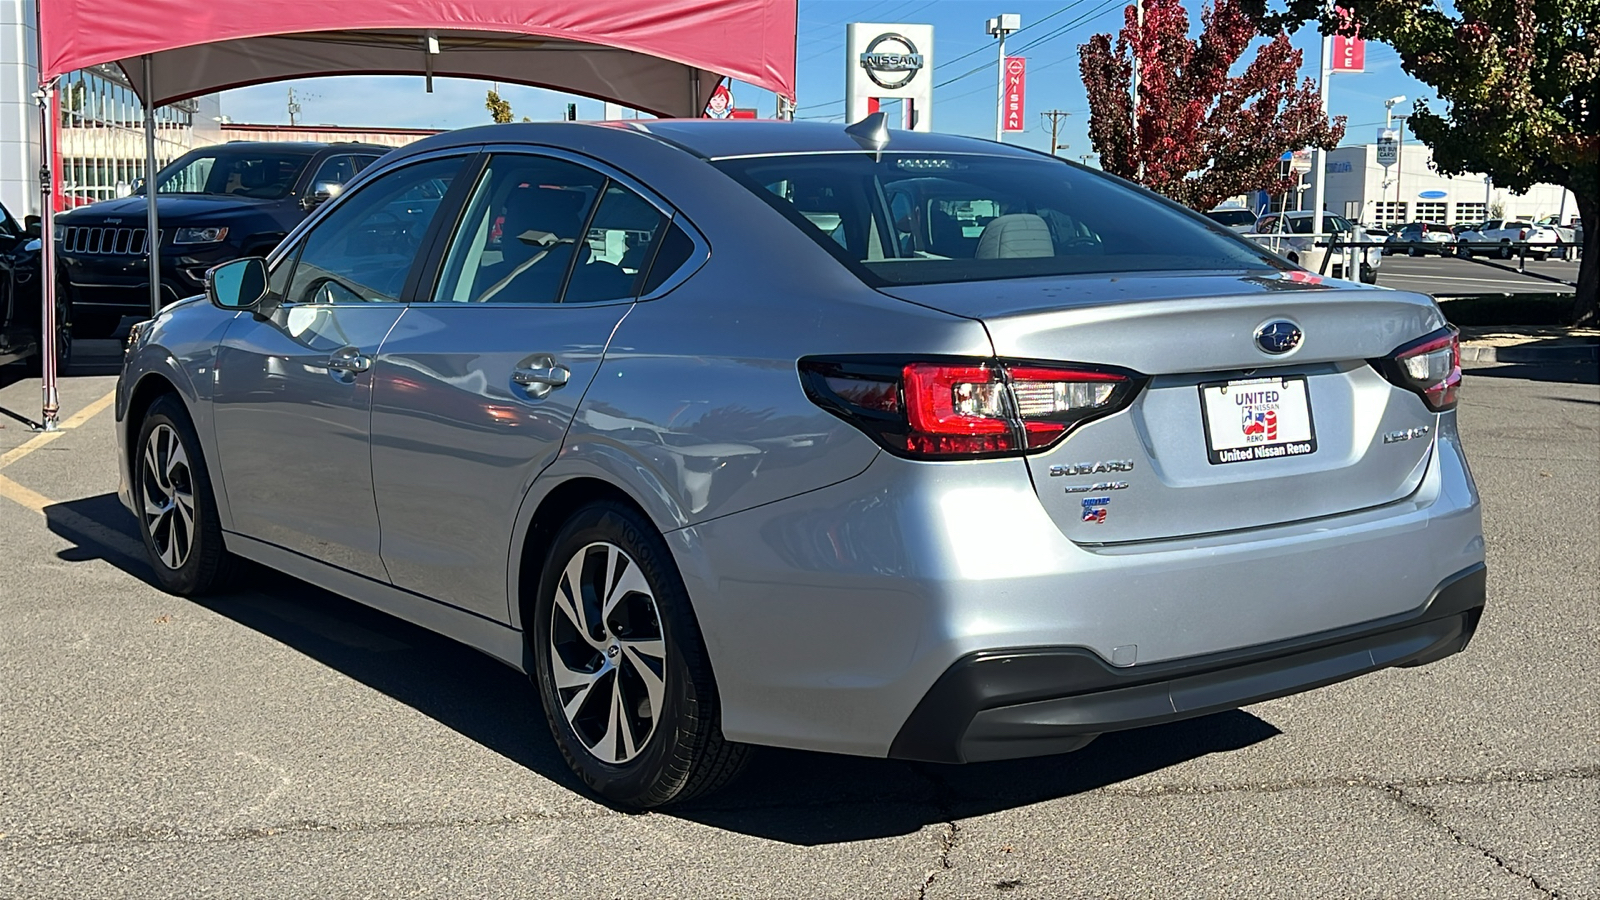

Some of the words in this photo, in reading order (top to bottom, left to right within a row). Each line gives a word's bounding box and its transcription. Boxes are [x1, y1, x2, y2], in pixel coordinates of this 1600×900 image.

[866, 56, 918, 66] NISSAN
[1009, 76, 1020, 128] NISSAN
[1235, 391, 1280, 406] UNITED
[1246, 435, 1264, 443] RENO
[1220, 447, 1253, 462] United
[1254, 445, 1285, 459] Nissan
[1286, 443, 1311, 455] Reno
[1049, 459, 1134, 477] SUBARU
